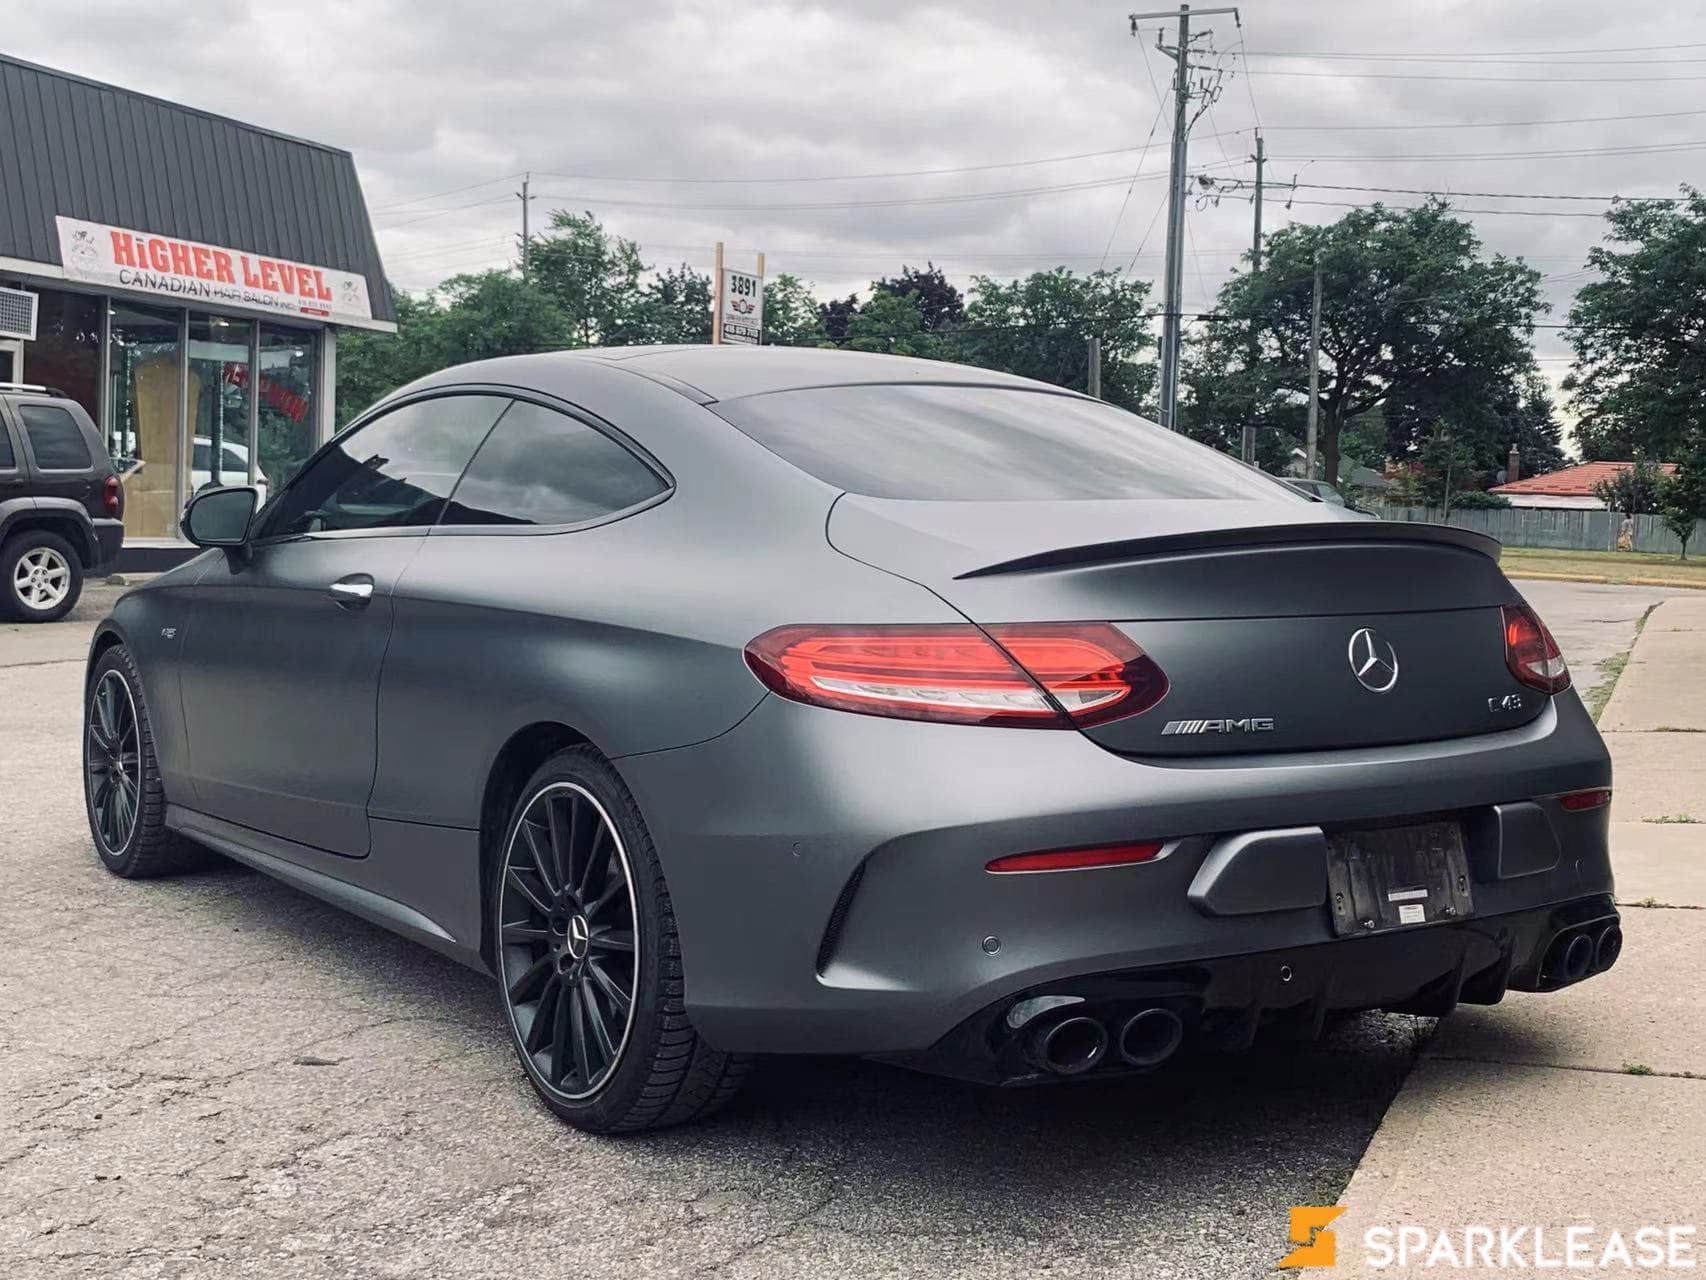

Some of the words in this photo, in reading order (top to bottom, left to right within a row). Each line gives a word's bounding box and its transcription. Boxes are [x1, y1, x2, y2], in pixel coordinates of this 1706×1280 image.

[119, 269, 211, 298] CANADIAN
[240, 255, 333, 301] LEVEL
[731, 275, 756, 297] 3891
